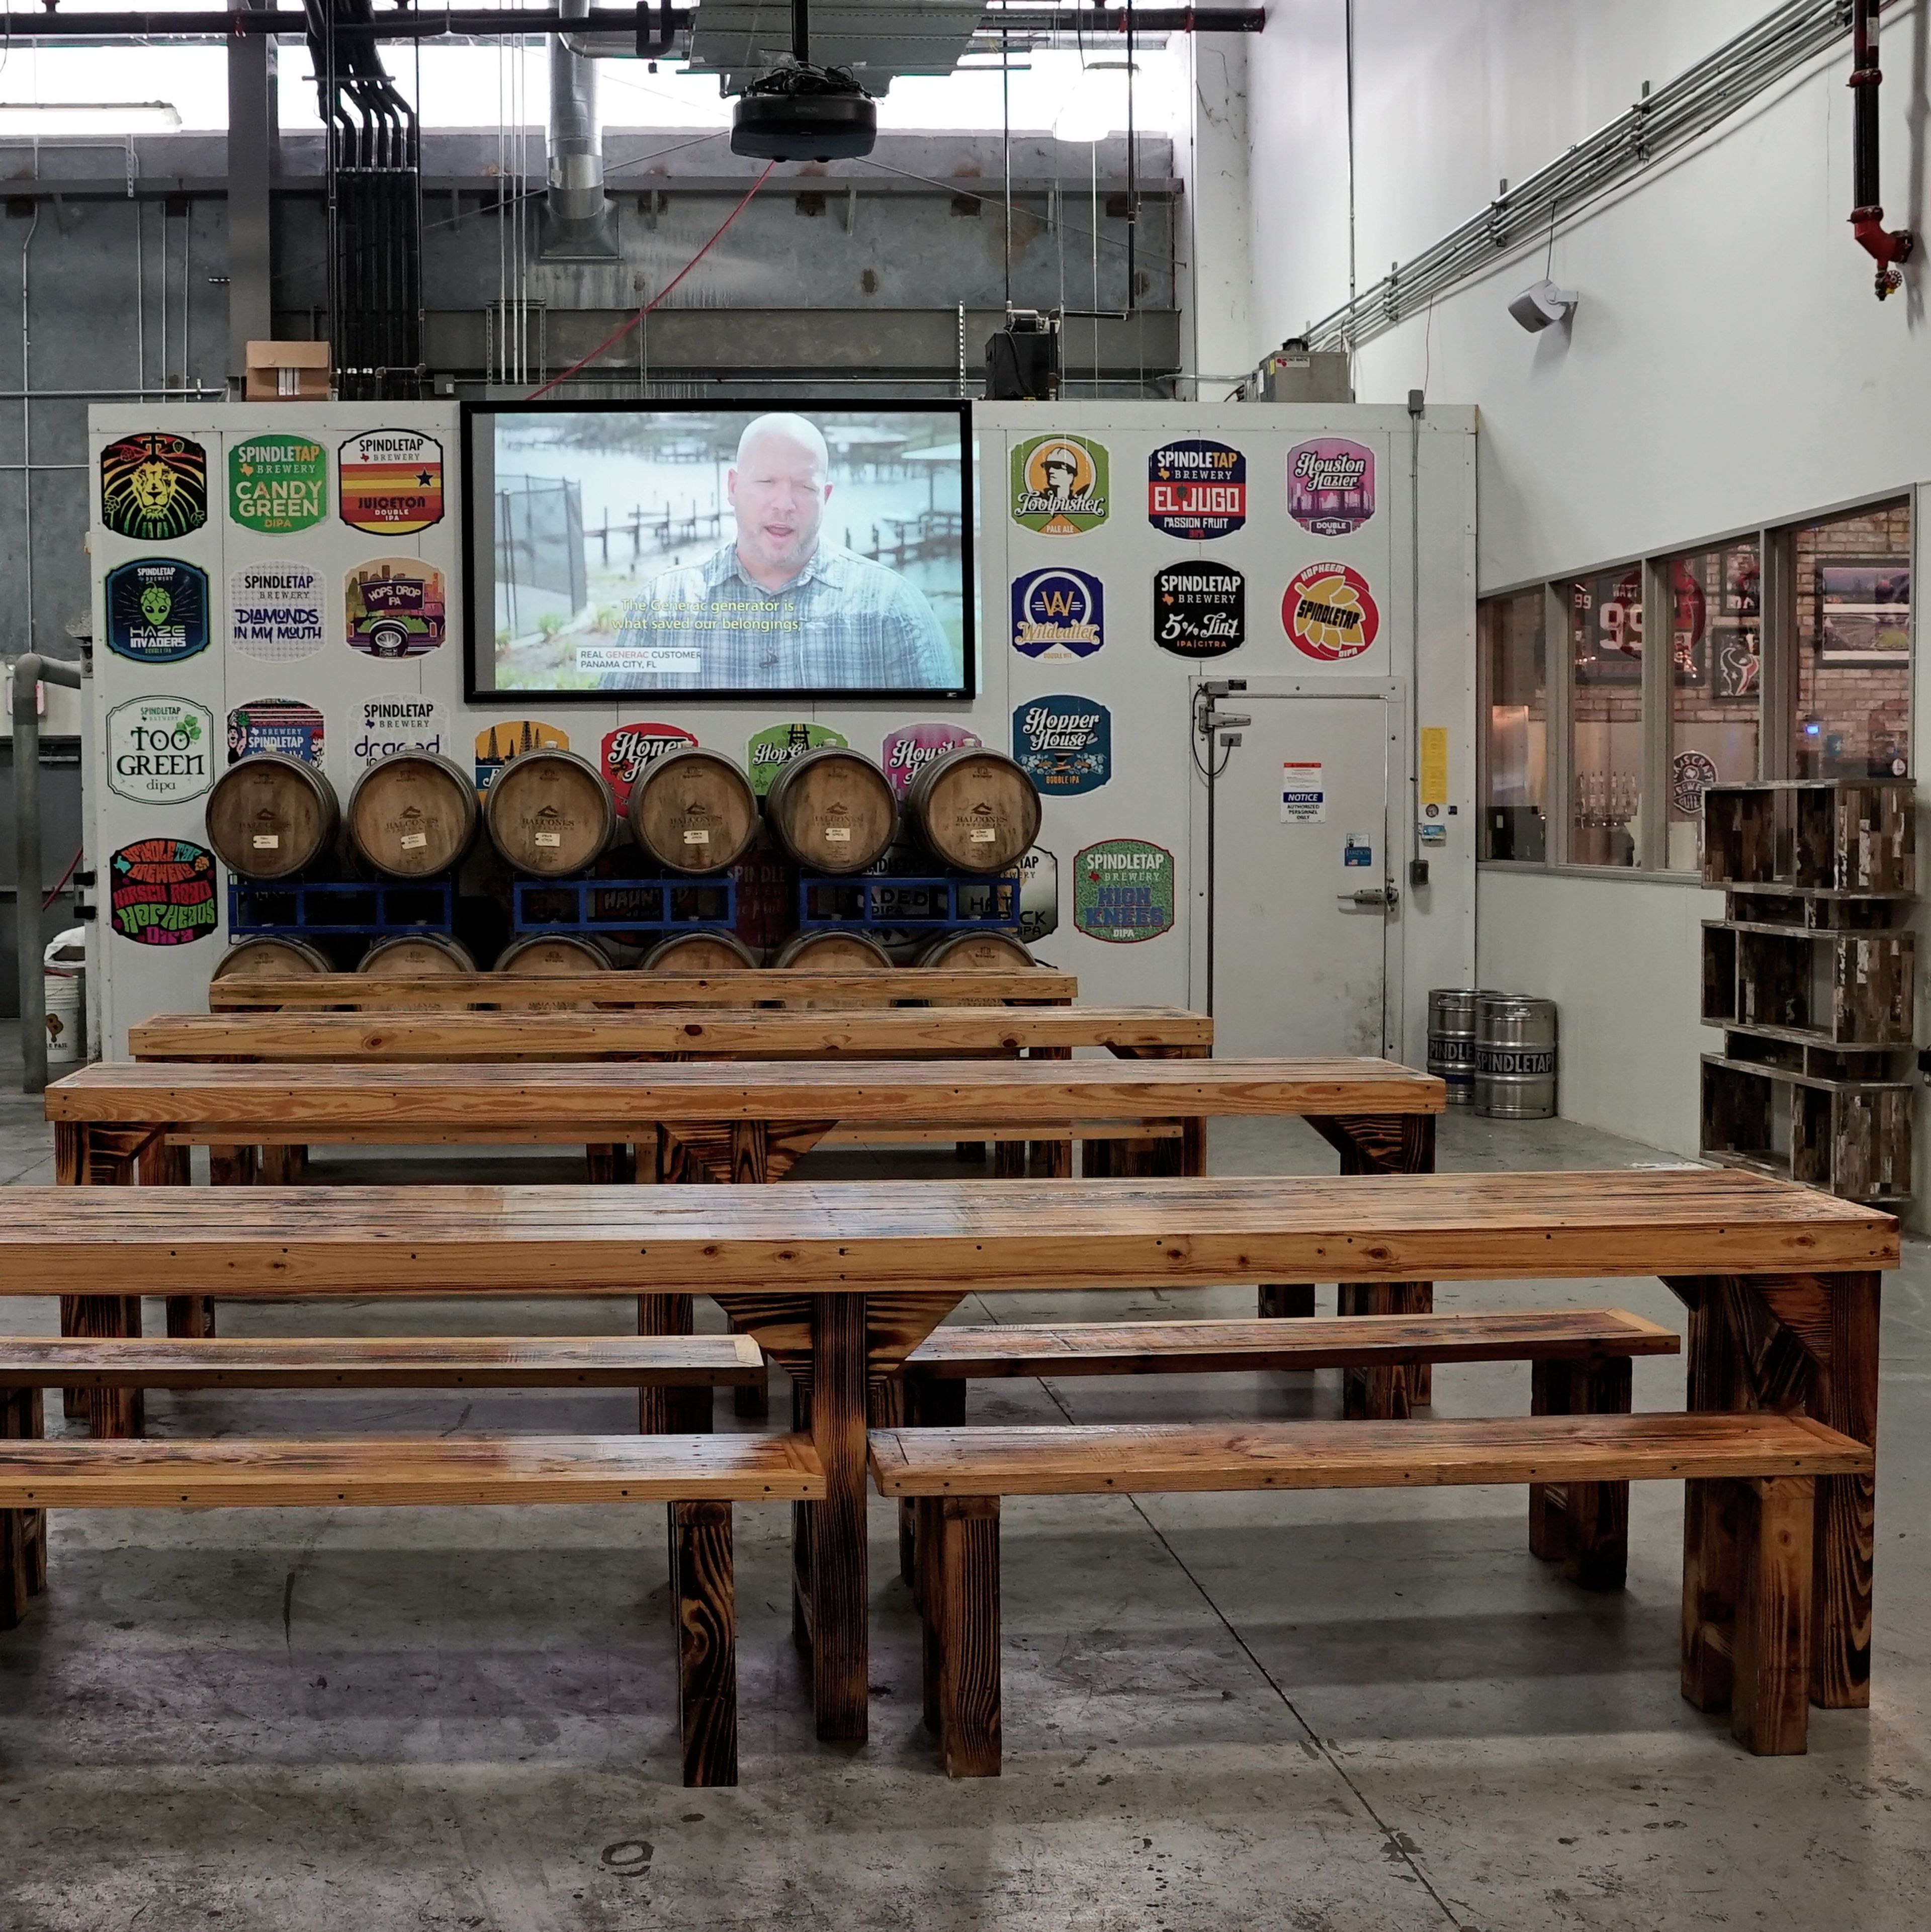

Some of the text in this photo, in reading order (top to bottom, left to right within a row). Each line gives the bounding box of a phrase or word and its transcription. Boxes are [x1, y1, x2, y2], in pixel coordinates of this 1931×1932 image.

[360, 439, 423, 452] SPINDLETAP
[238, 446, 320, 462] SPINDLETAP
[1158, 451, 1237, 468] SPINDLETAP
[257, 465, 315, 473] BREWERY
[1295, 452, 1365, 477] Houston
[1175, 470, 1232, 480] BREWERY
[1306, 471, 1358, 491] Hazier
[236, 480, 322, 499] CANDY
[1014, 490, 1104, 517] Toolpusher
[1155, 487, 1239, 512] EL JUGO
[239, 499, 318, 517] GREEN
[264, 519, 292, 528] DIPA
[1046, 525, 1074, 533] PALE ALE
[1164, 517, 1228, 529] PASSION FRUIT
[137, 567, 175, 576] SPINDLETAP
[1301, 564, 1345, 581] HOPHEEM
[245, 576, 313, 588] SPINDLETAP
[1161, 575, 1241, 592] SPINDLETAP
[368, 585, 421, 601] HOPS DROP
[1178, 594, 1236, 603] BREWERY
[621, 599, 794, 614] The Generac generator is
[235, 608, 319, 625] DIAMONDS
[1297, 599, 1360, 630] SPINDLETAP
[130, 626, 186, 637] HAZE
[611, 618, 801, 633] what saved our belongings,
[1161, 612, 1240, 639] 5% Tint
[130, 637, 186, 648] INVADERS
[234, 627, 321, 644] IN MY MOUTH
[581, 651, 701, 659] REAL GENERAC CUSTOMER
[1338, 647, 1357, 657] DIPA
[581, 661, 620, 669] PANAMA
[623, 661, 644, 670] CITY,
[141, 707, 181, 715] SPINDLETAP
[364, 704, 433, 718] SPINDLETAP
[1023, 708, 1099, 734] Hopper
[131, 727, 190, 751] TOO
[248, 737, 304, 748] SPINDLETAP
[1030, 729, 1086, 750] House
[117, 754, 205, 775] GREEN
[146, 779, 176, 793] dipa
[1046, 775, 1079, 784] DOUBLE IPA
[1288, 794, 1319, 802] NOTICE
[1087, 854, 1164, 869] SPINDLETAP
[127, 863, 197, 884] BREWERY
[1104, 872, 1160, 882] BREWERY
[1098, 887, 1152, 907] HIGH
[1086, 907, 1164, 927] KNEES
[1113, 929, 1134, 937] DIPA
[1477, 1052, 1551, 1073] SPINDLETAP
